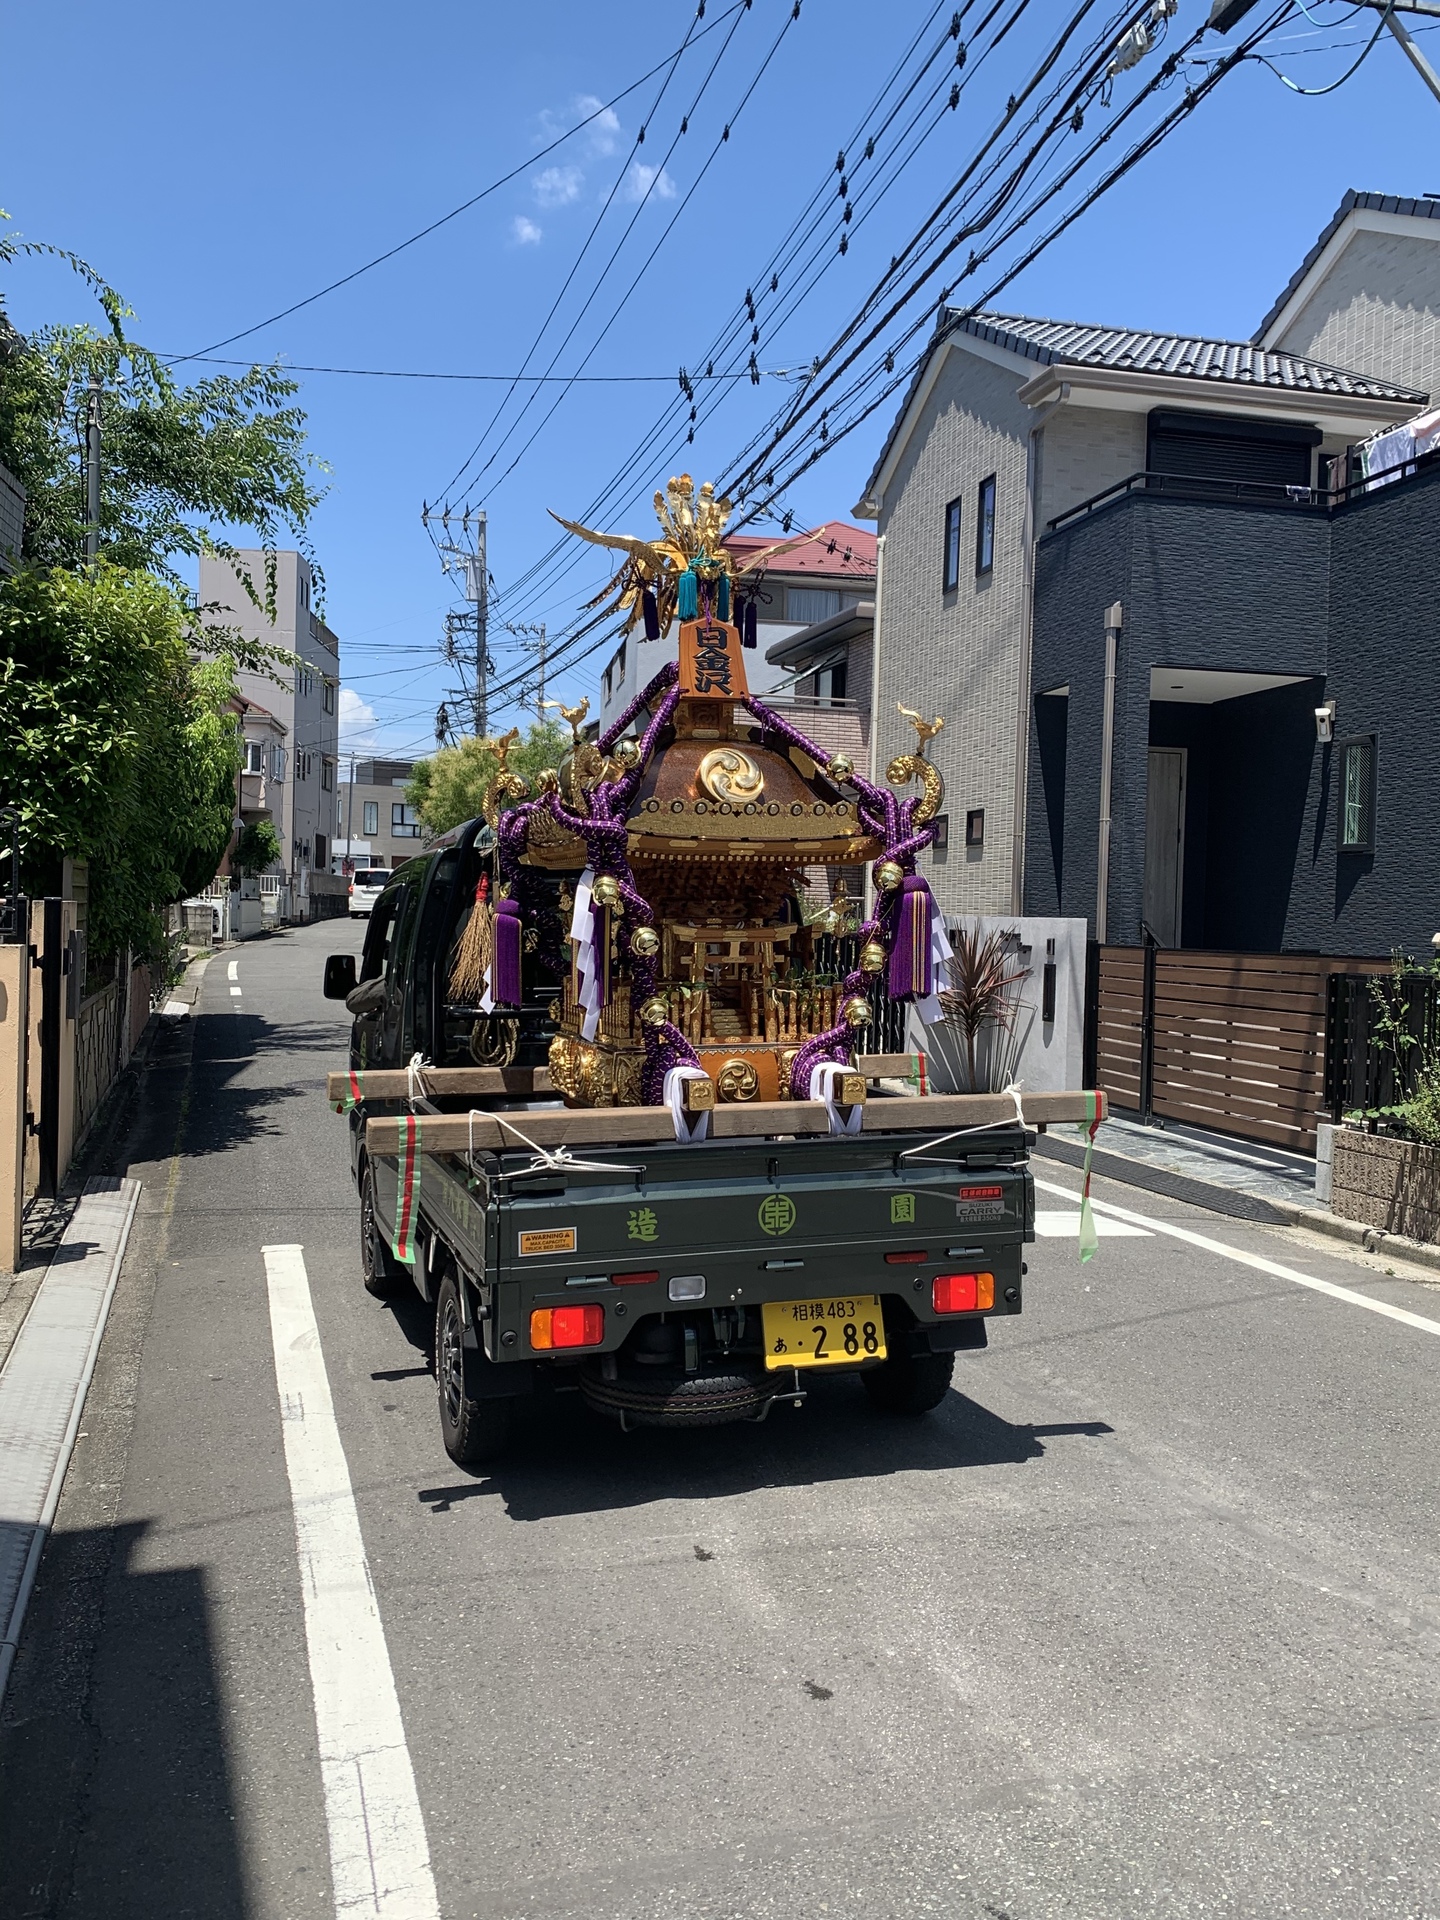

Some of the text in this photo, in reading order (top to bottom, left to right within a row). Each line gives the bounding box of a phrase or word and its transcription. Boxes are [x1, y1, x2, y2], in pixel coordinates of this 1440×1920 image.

[627, 1193, 916, 1242] 造 園
[960, 1207, 1002, 1215] CARRY
